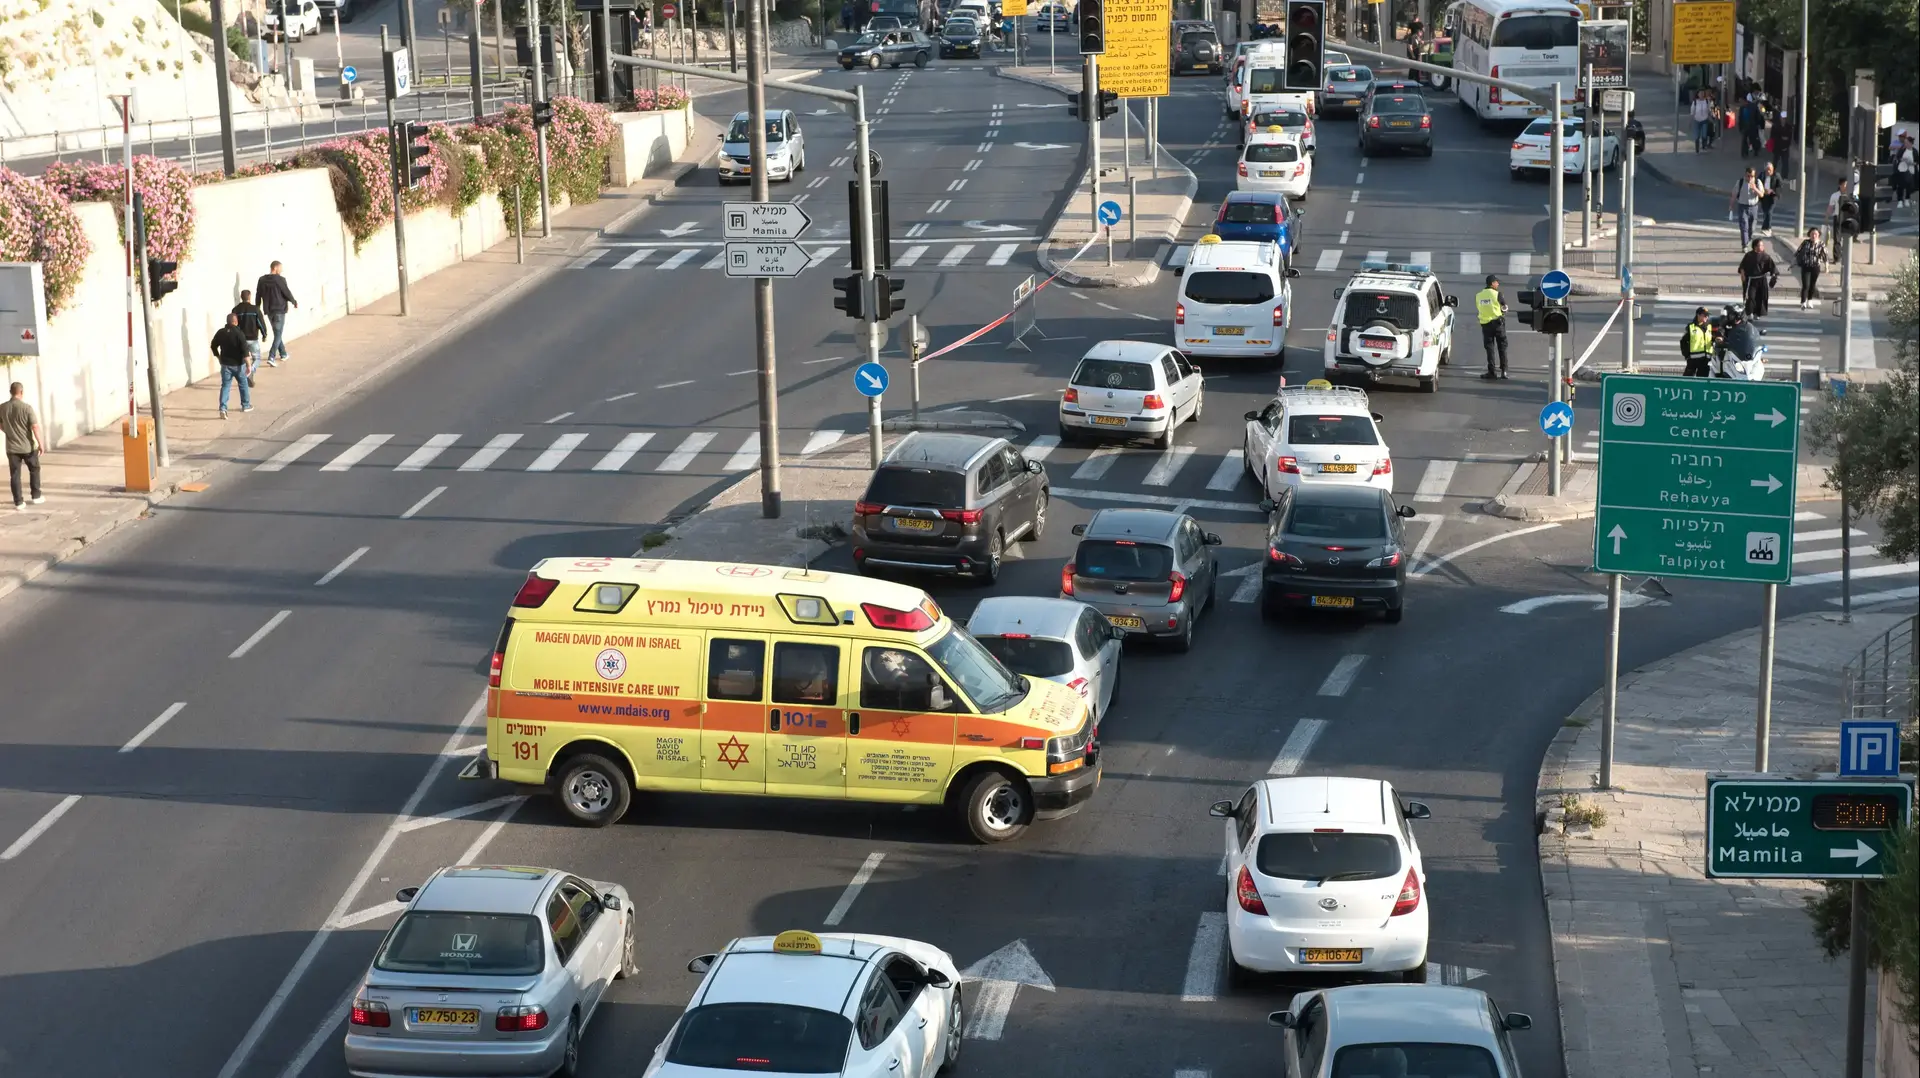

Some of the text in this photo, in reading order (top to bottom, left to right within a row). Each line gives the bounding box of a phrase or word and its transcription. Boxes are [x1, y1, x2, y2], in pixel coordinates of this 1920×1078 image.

[1107, 14, 1128, 24] לפניך
[752, 205, 787, 215] ממילא
[757, 246, 786, 256] קרתא
[1654, 387, 1746, 403] מרכז העיר
[1661, 407, 1736, 424] مركز المدينة
[1670, 426, 1726, 439] Center
[1671, 453, 1723, 468] רחביה
[1660, 491, 1730, 507] Rehavya
[1662, 518, 1724, 533] תלפיות
[1659, 555, 1726, 570] Talpiyot
[647, 598, 765, 617] ניידת טיפול נמרץ
[536, 632, 681, 649] MAGEN DAVID ADOM IN ISRAEL
[534, 679, 680, 696] MOBILE INTENSIVE CARE UNIT
[578, 703, 670, 721] www.mdais.org
[784, 712, 812, 727] 101
[506, 723, 546, 736] ירושלים
[512, 741, 539, 760] 191
[792, 753, 816, 761] אדום
[778, 759, 816, 769] בישראל
[1725, 792, 1800, 812] ממילא
[1836, 803, 1885, 824] 800
[1734, 822, 1790, 841] ماميلا
[1720, 846, 1802, 863] Mamila
